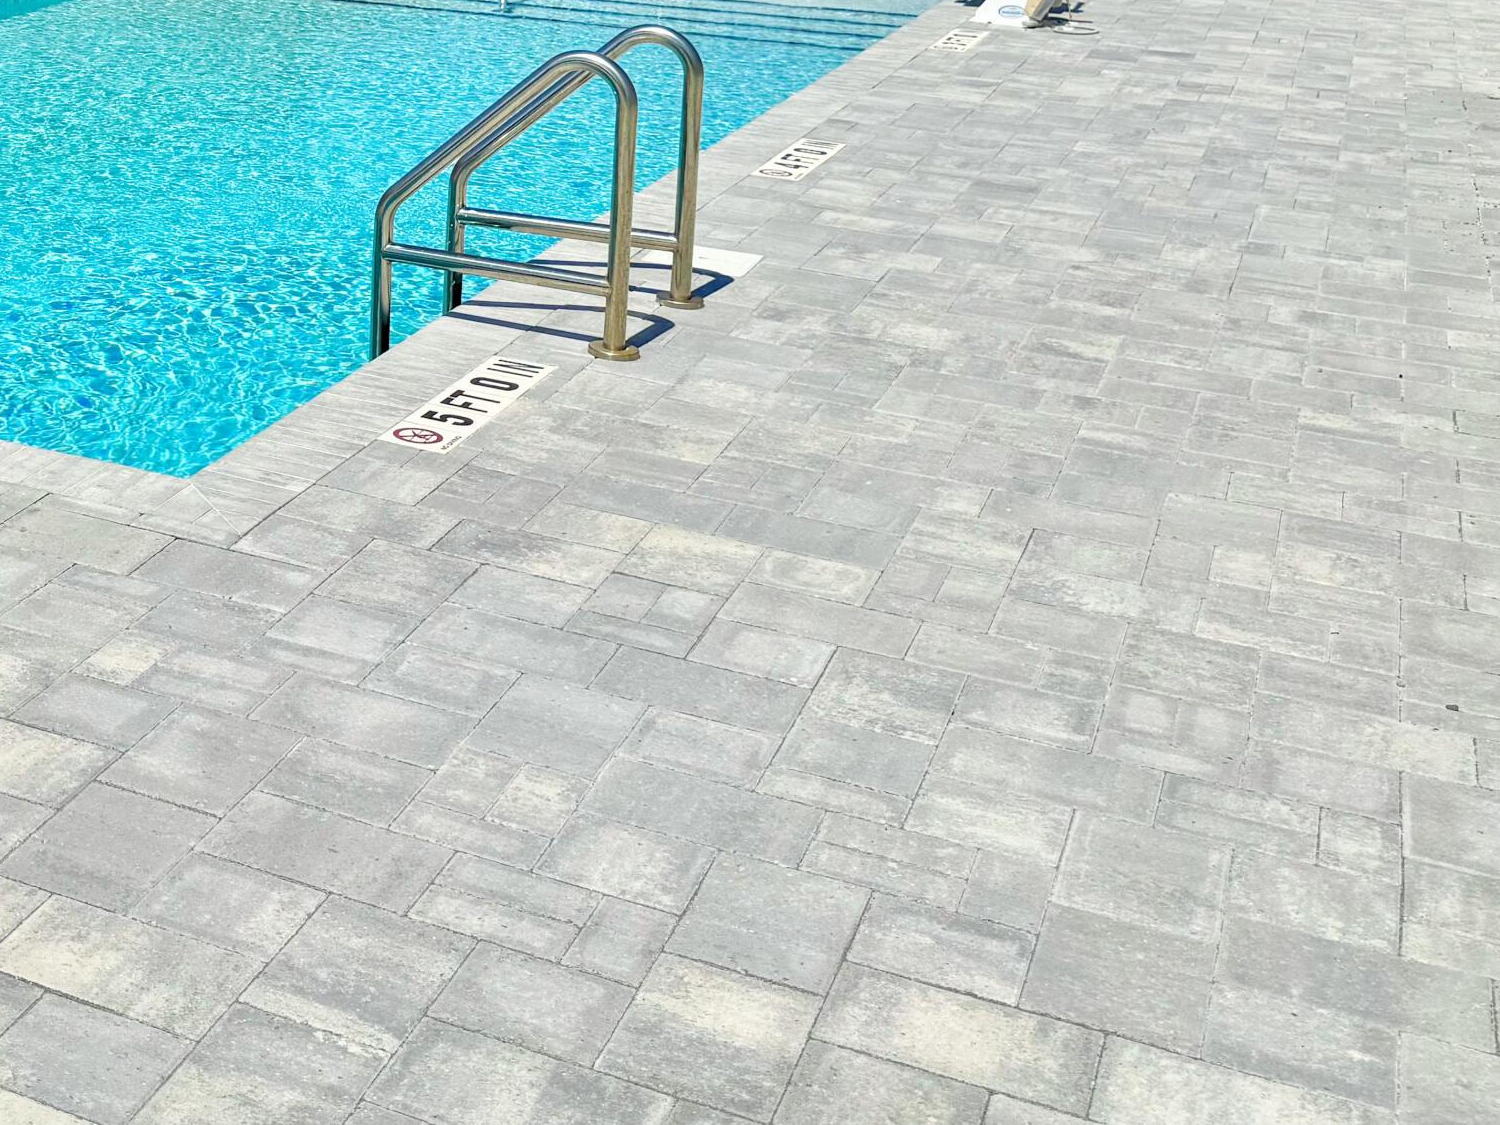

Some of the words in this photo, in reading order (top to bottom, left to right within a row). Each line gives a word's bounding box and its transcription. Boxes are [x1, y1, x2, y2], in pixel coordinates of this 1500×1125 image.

[487, 359, 545, 378] IN
[469, 376, 520, 392] 0
[440, 389, 501, 413] FT
[420, 410, 474, 427] 5
